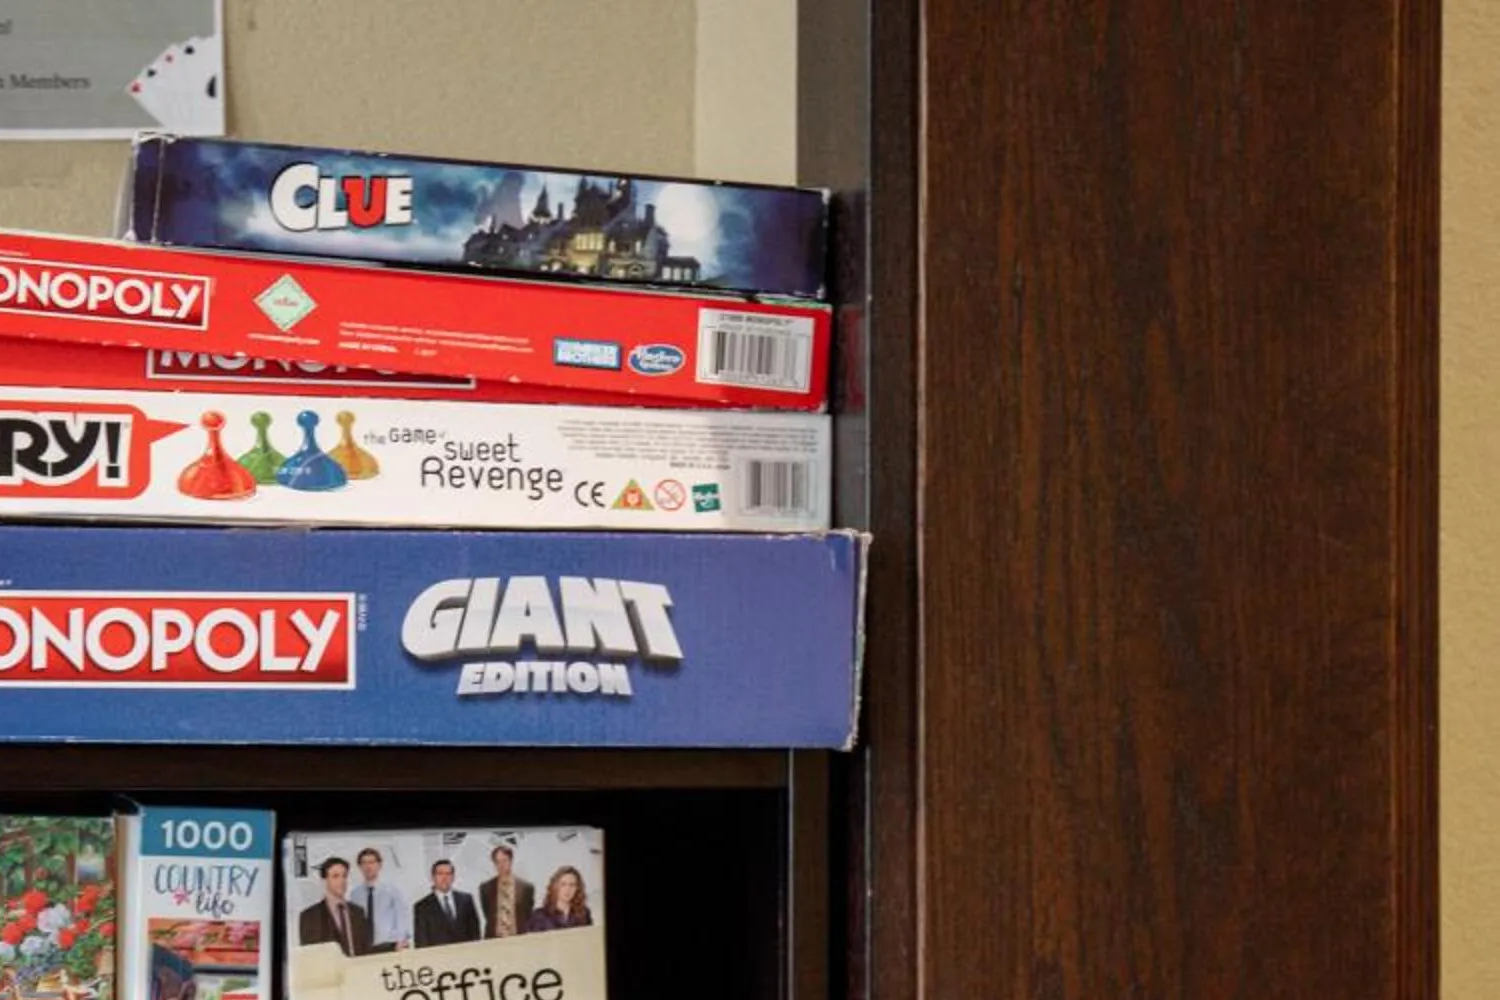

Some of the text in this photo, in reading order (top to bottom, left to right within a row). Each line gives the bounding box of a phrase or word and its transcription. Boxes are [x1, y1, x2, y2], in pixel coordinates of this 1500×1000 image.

[10, 74, 91, 89] Members
[269, 162, 414, 231] CLUE
[421, 456, 563, 500] Revenge
[401, 575, 684, 663] GIANT
[457, 660, 632, 696] EDITION
[160, 820, 253, 851] 1000
[154, 864, 259, 897] COUNTRY
[381, 965, 434, 992] the
